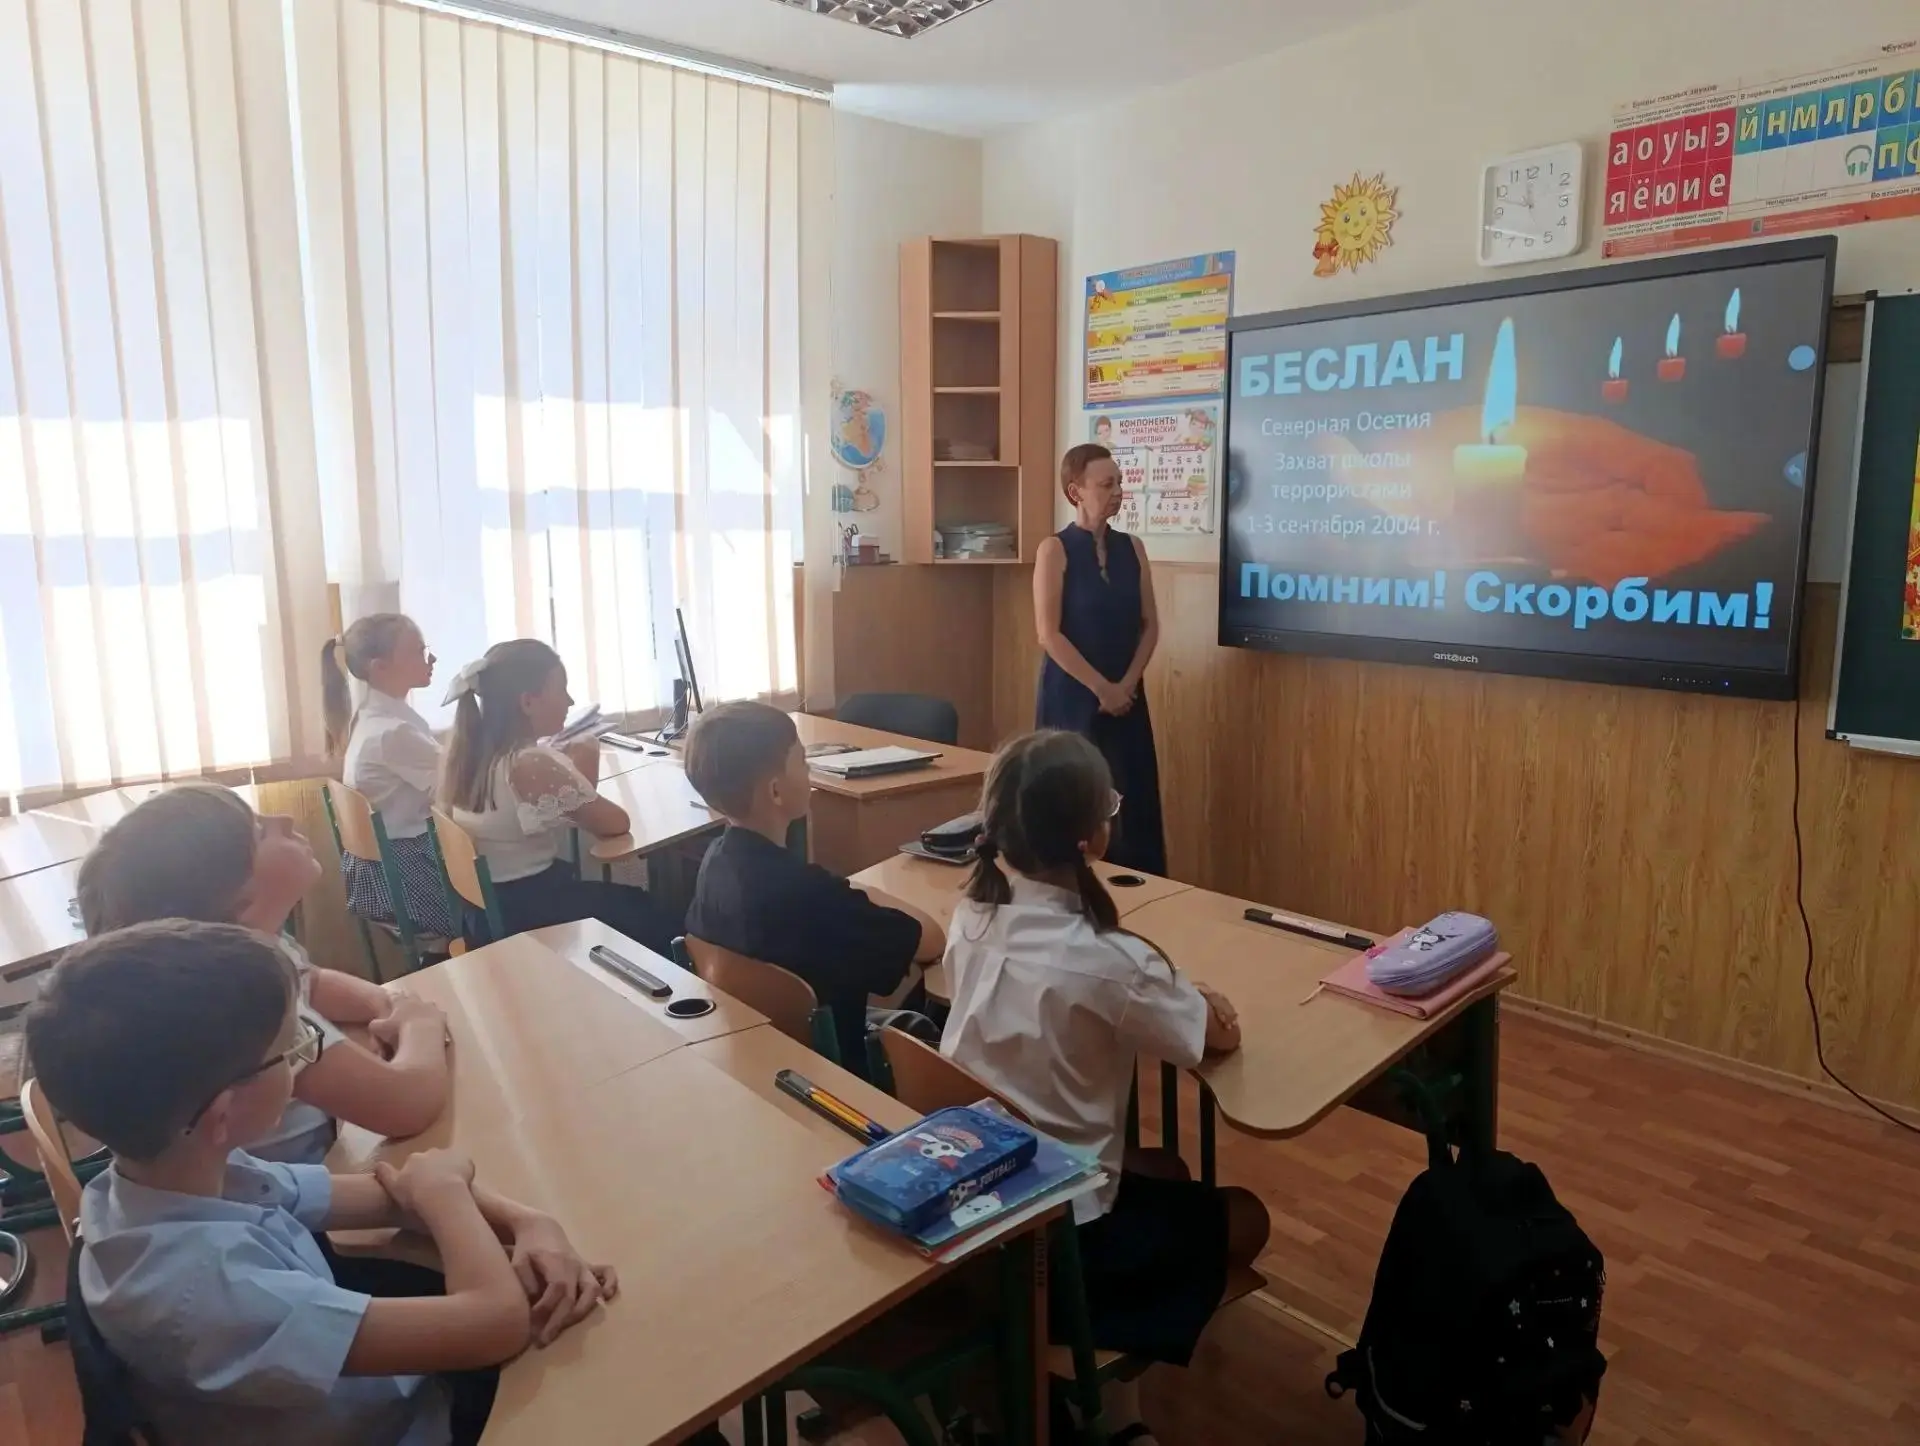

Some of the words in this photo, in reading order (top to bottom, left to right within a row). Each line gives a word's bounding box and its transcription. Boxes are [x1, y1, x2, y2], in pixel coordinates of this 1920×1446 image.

[1525, 166, 1540, 180] 12
[1559, 172, 1570, 186] 2
[1558, 194, 1569, 208] 3
[1557, 215, 1567, 227] 4
[1543, 231, 1553, 244] 5
[1240, 333, 1465, 397] БЕСЛАН
[1119, 416, 1178, 429] КОМПОНЕНТЫ
[1261, 417, 1350, 439] Северная
[1356, 411, 1432, 432] Осетия
[1120, 425, 1177, 436] МАТЕМАТИЧЕСКИХ
[1274, 452, 1335, 471] Захват
[1340, 451, 1412, 470] школы
[1271, 482, 1412, 503] террористами
[1131, 502, 1137, 511] 6
[1156, 503, 1162, 511] 4
[1173, 502, 1180, 511] 2
[1247, 515, 1274, 534] 1-3
[1278, 514, 1366, 539] сентября
[1371, 515, 1421, 535] 2004
[1428, 520, 1440, 536] г.
[1240, 562, 1447, 609] Помним!
[1464, 570, 1774, 630] Скорбим!
[980, 1157, 1017, 1189] FOOTBALL
